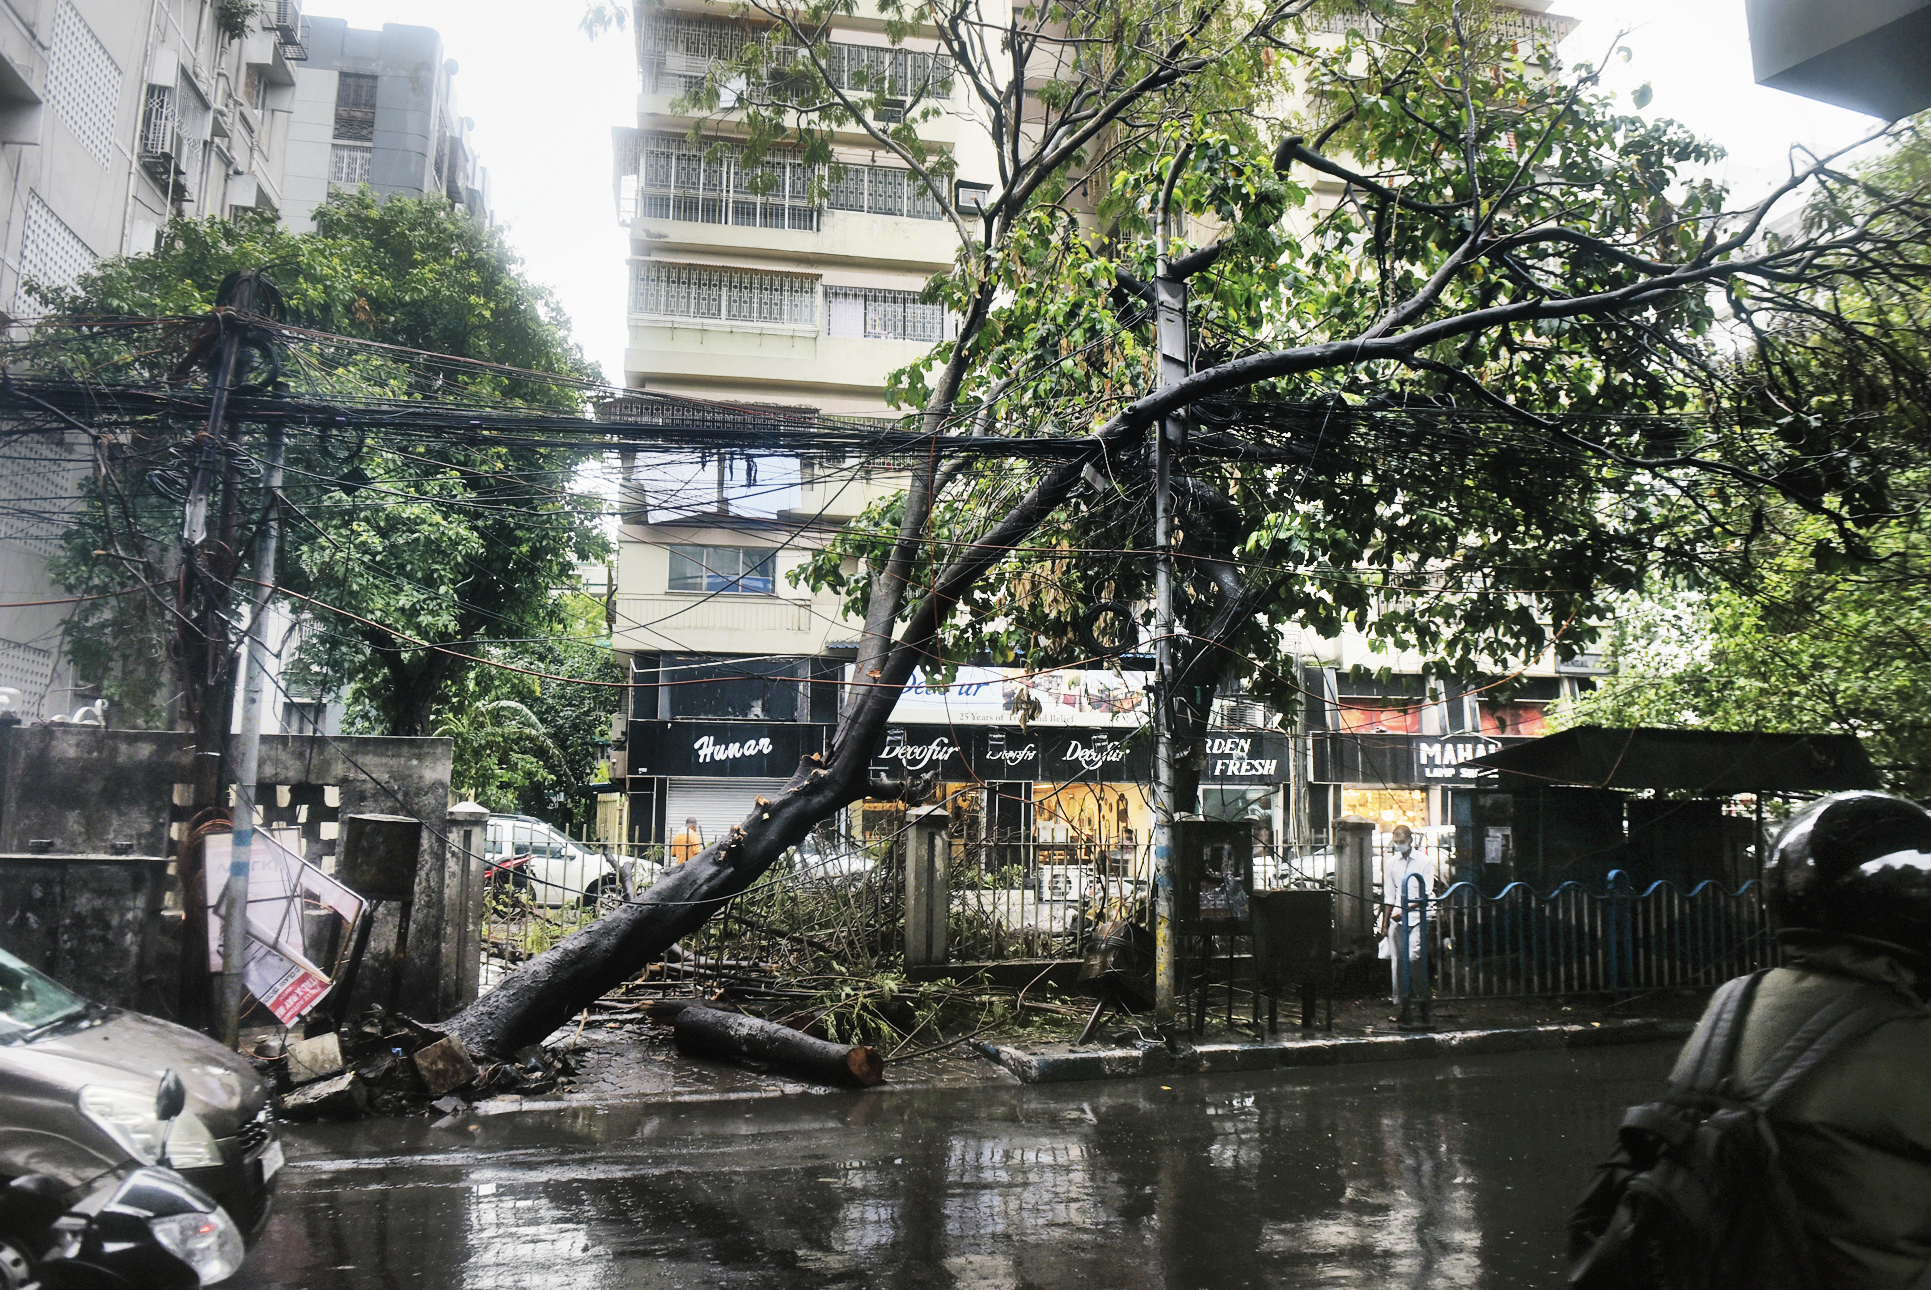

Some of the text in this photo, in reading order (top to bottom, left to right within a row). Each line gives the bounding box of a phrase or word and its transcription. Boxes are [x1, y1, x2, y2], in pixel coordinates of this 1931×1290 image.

[959, 713, 969, 721] 25
[971, 713, 994, 722] Years
[995, 713, 1004, 722] of
[1050, 714, 1076, 723] Belief
[693, 735, 773, 763] Hunar
[877, 737, 961, 770] Decofur
[1213, 759, 1278, 775] FRESH
[1424, 767, 1456, 778] LAMP
